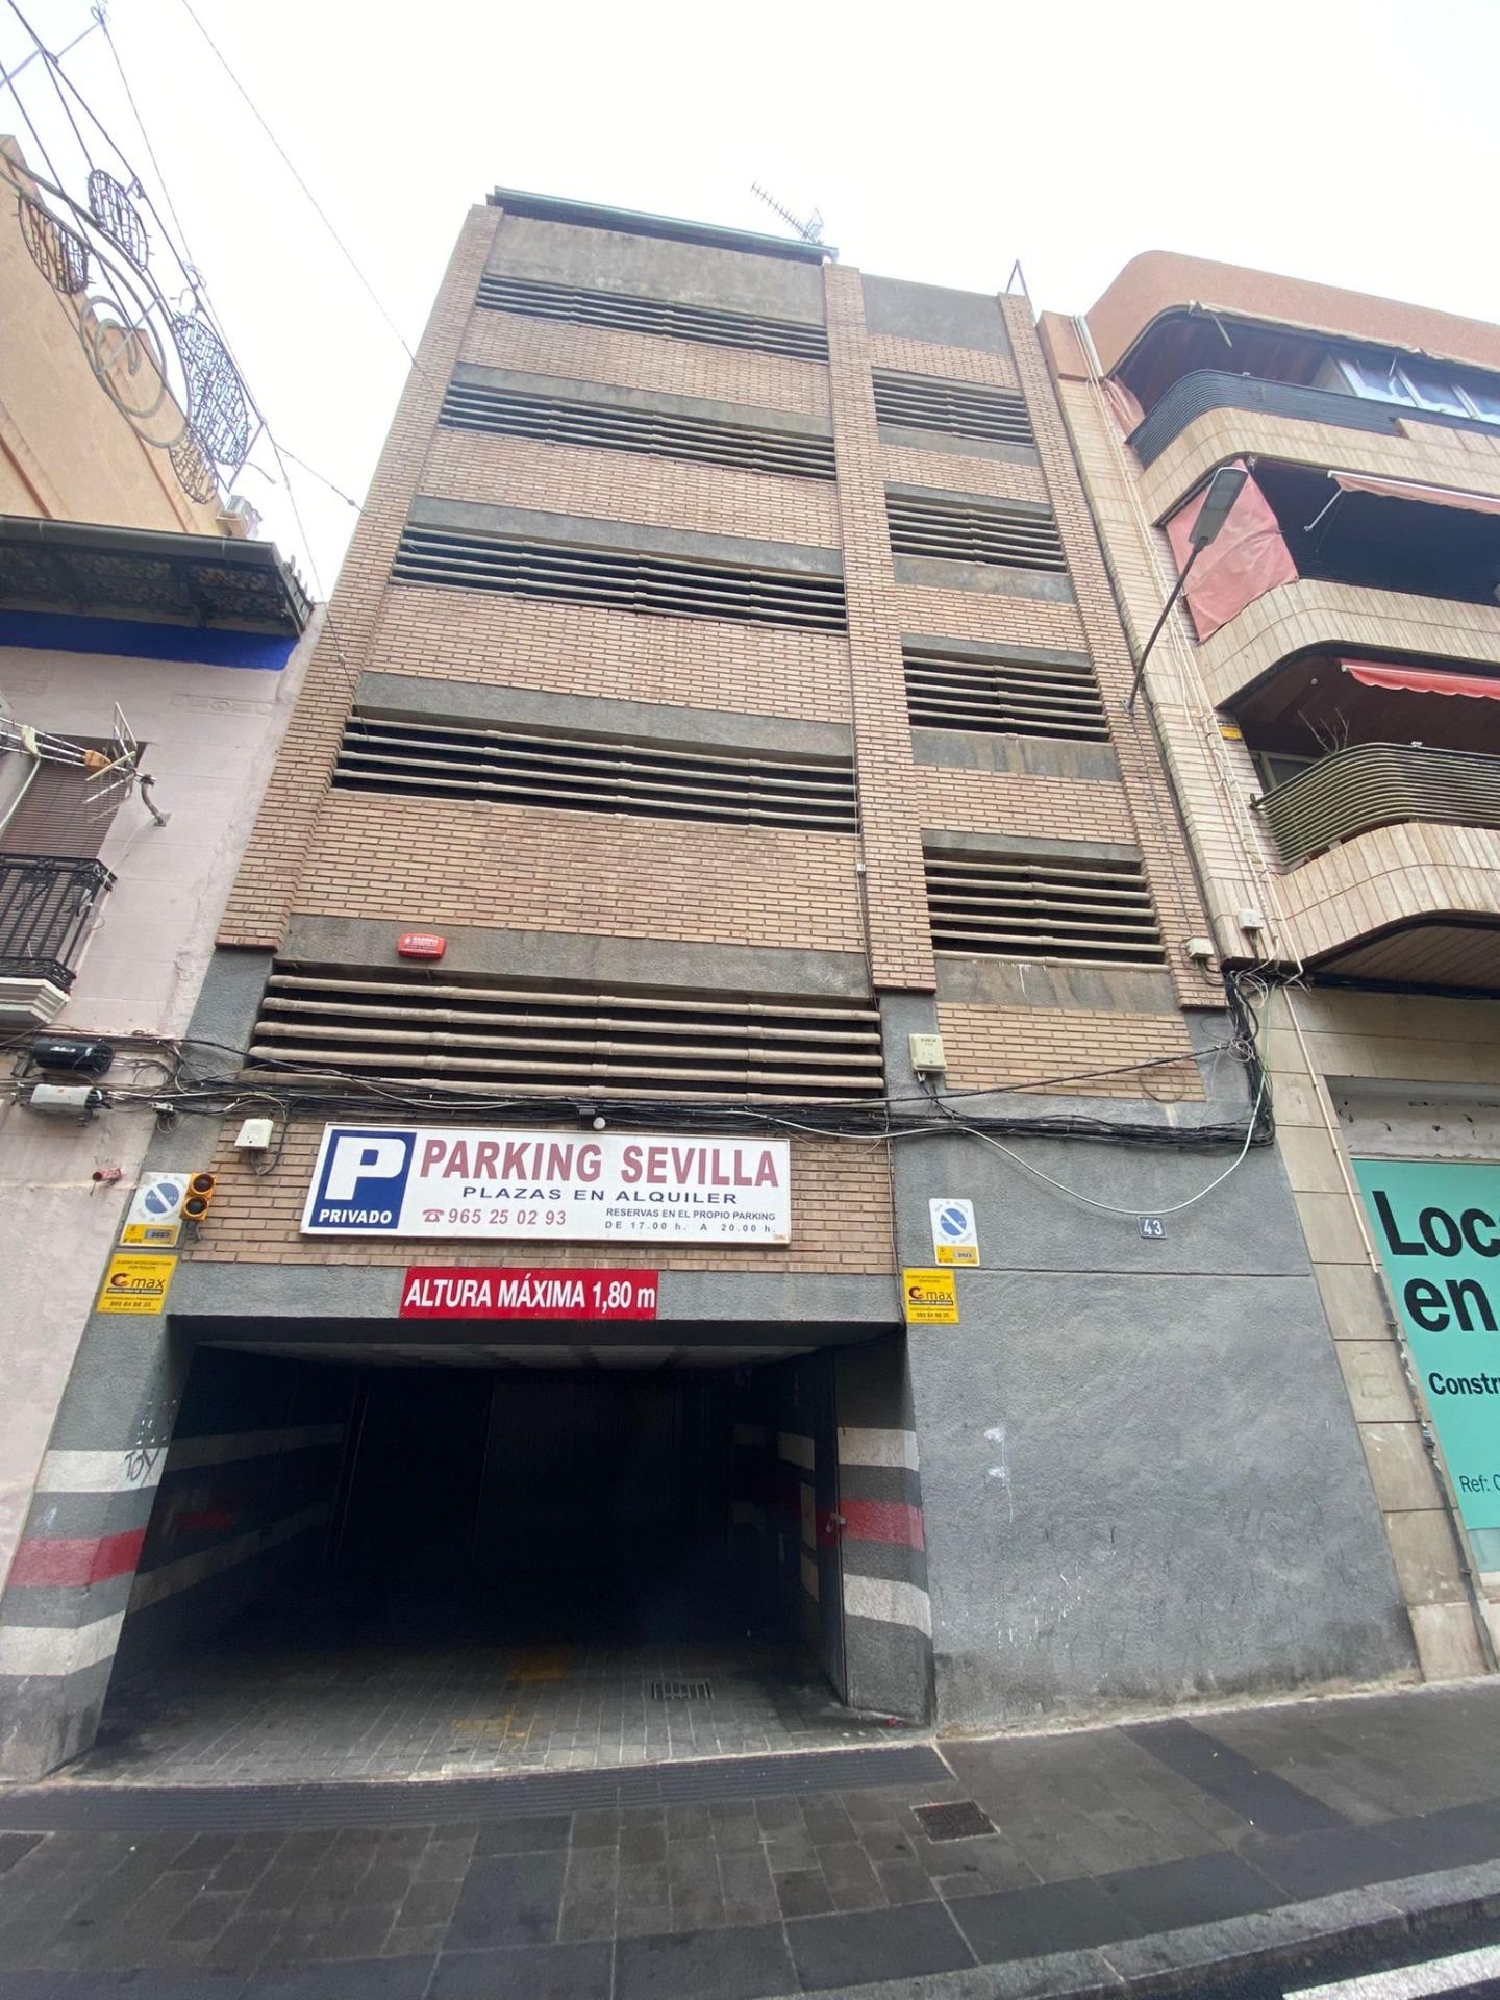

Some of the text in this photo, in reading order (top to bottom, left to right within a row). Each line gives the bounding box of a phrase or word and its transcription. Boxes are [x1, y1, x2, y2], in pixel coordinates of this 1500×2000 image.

[324, 1136, 407, 1201] P
[420, 1139, 779, 1188] PARKING SEVILLA
[463, 1187, 737, 1204] PLAZAS EN ALQUILER
[318, 1208, 393, 1225] PRIVADO
[449, 1208, 567, 1226] 965 25 02 93
[606, 1207, 776, 1221] RESERVAS EN EL PROPIO PARKING
[605, 1220, 622, 1229] DE
[699, 1223, 708, 1231] A
[1144, 1219, 1162, 1235] 43
[1372, 1190, 1500, 1258] Loc
[404, 1272, 656, 1314] ALTURA MÁXIMA 1,80 m
[1404, 1277, 1499, 1332] en
[1428, 1372, 1500, 1396] Constr
[1459, 1474, 1491, 1492] Ref:
